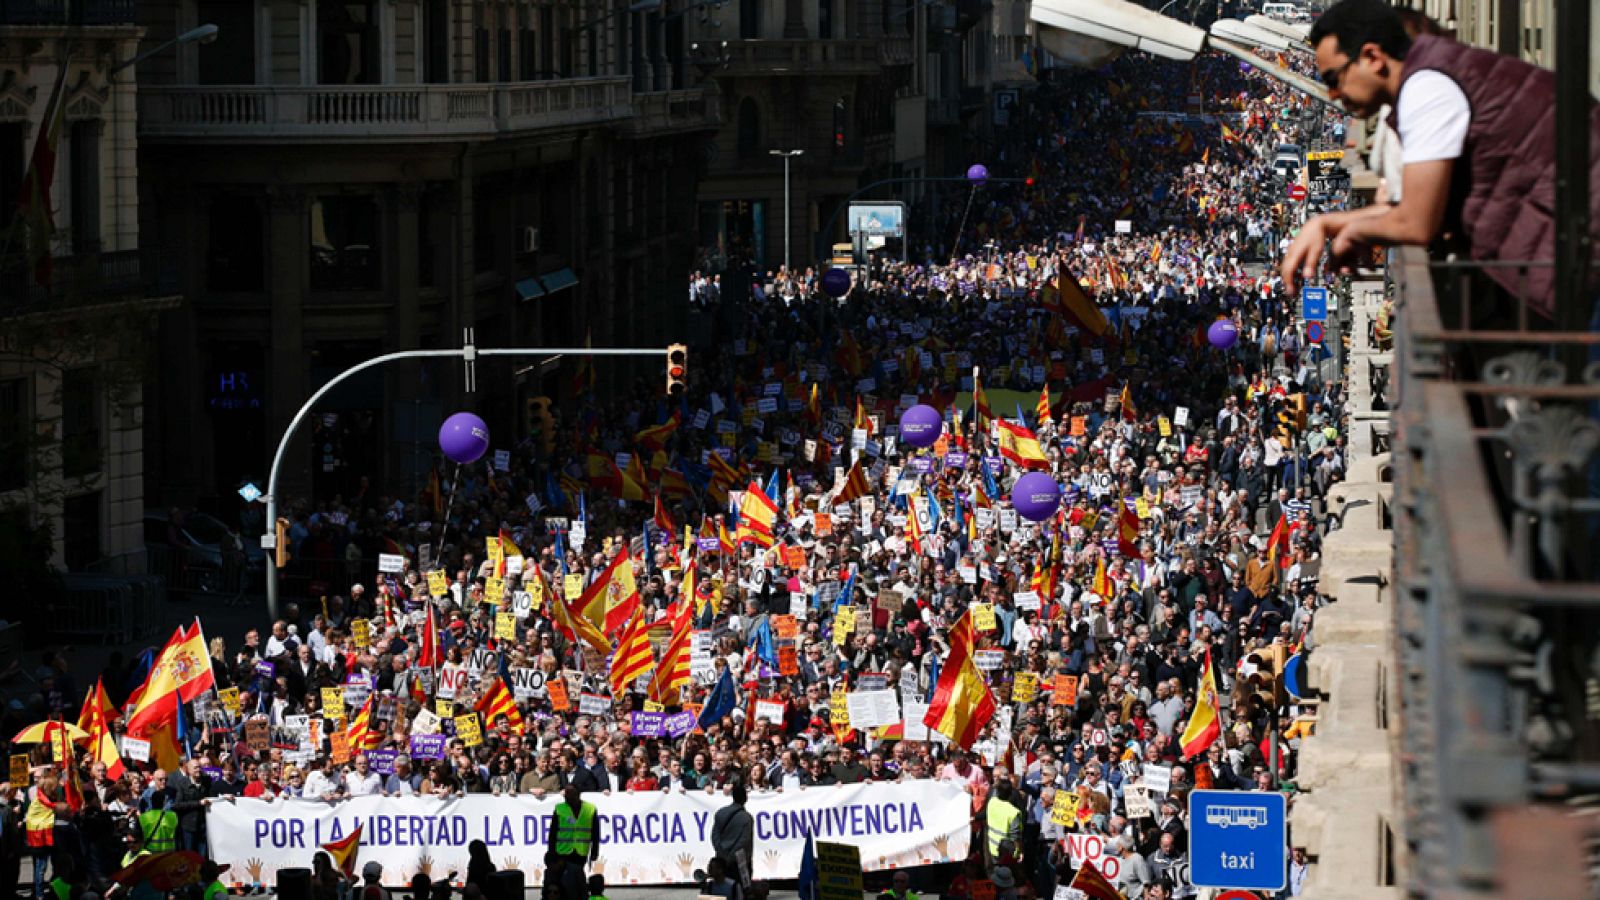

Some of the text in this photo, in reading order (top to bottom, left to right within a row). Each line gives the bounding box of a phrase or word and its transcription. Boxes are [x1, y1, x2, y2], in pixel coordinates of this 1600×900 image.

[441, 668, 467, 689] NO
[516, 669, 543, 690] NO
[255, 801, 924, 848] POR LA LIBERTAD LA DECRACIA Y CONVIVENCIA
[1068, 834, 1103, 861] NO
[1220, 850, 1255, 870] taxi
